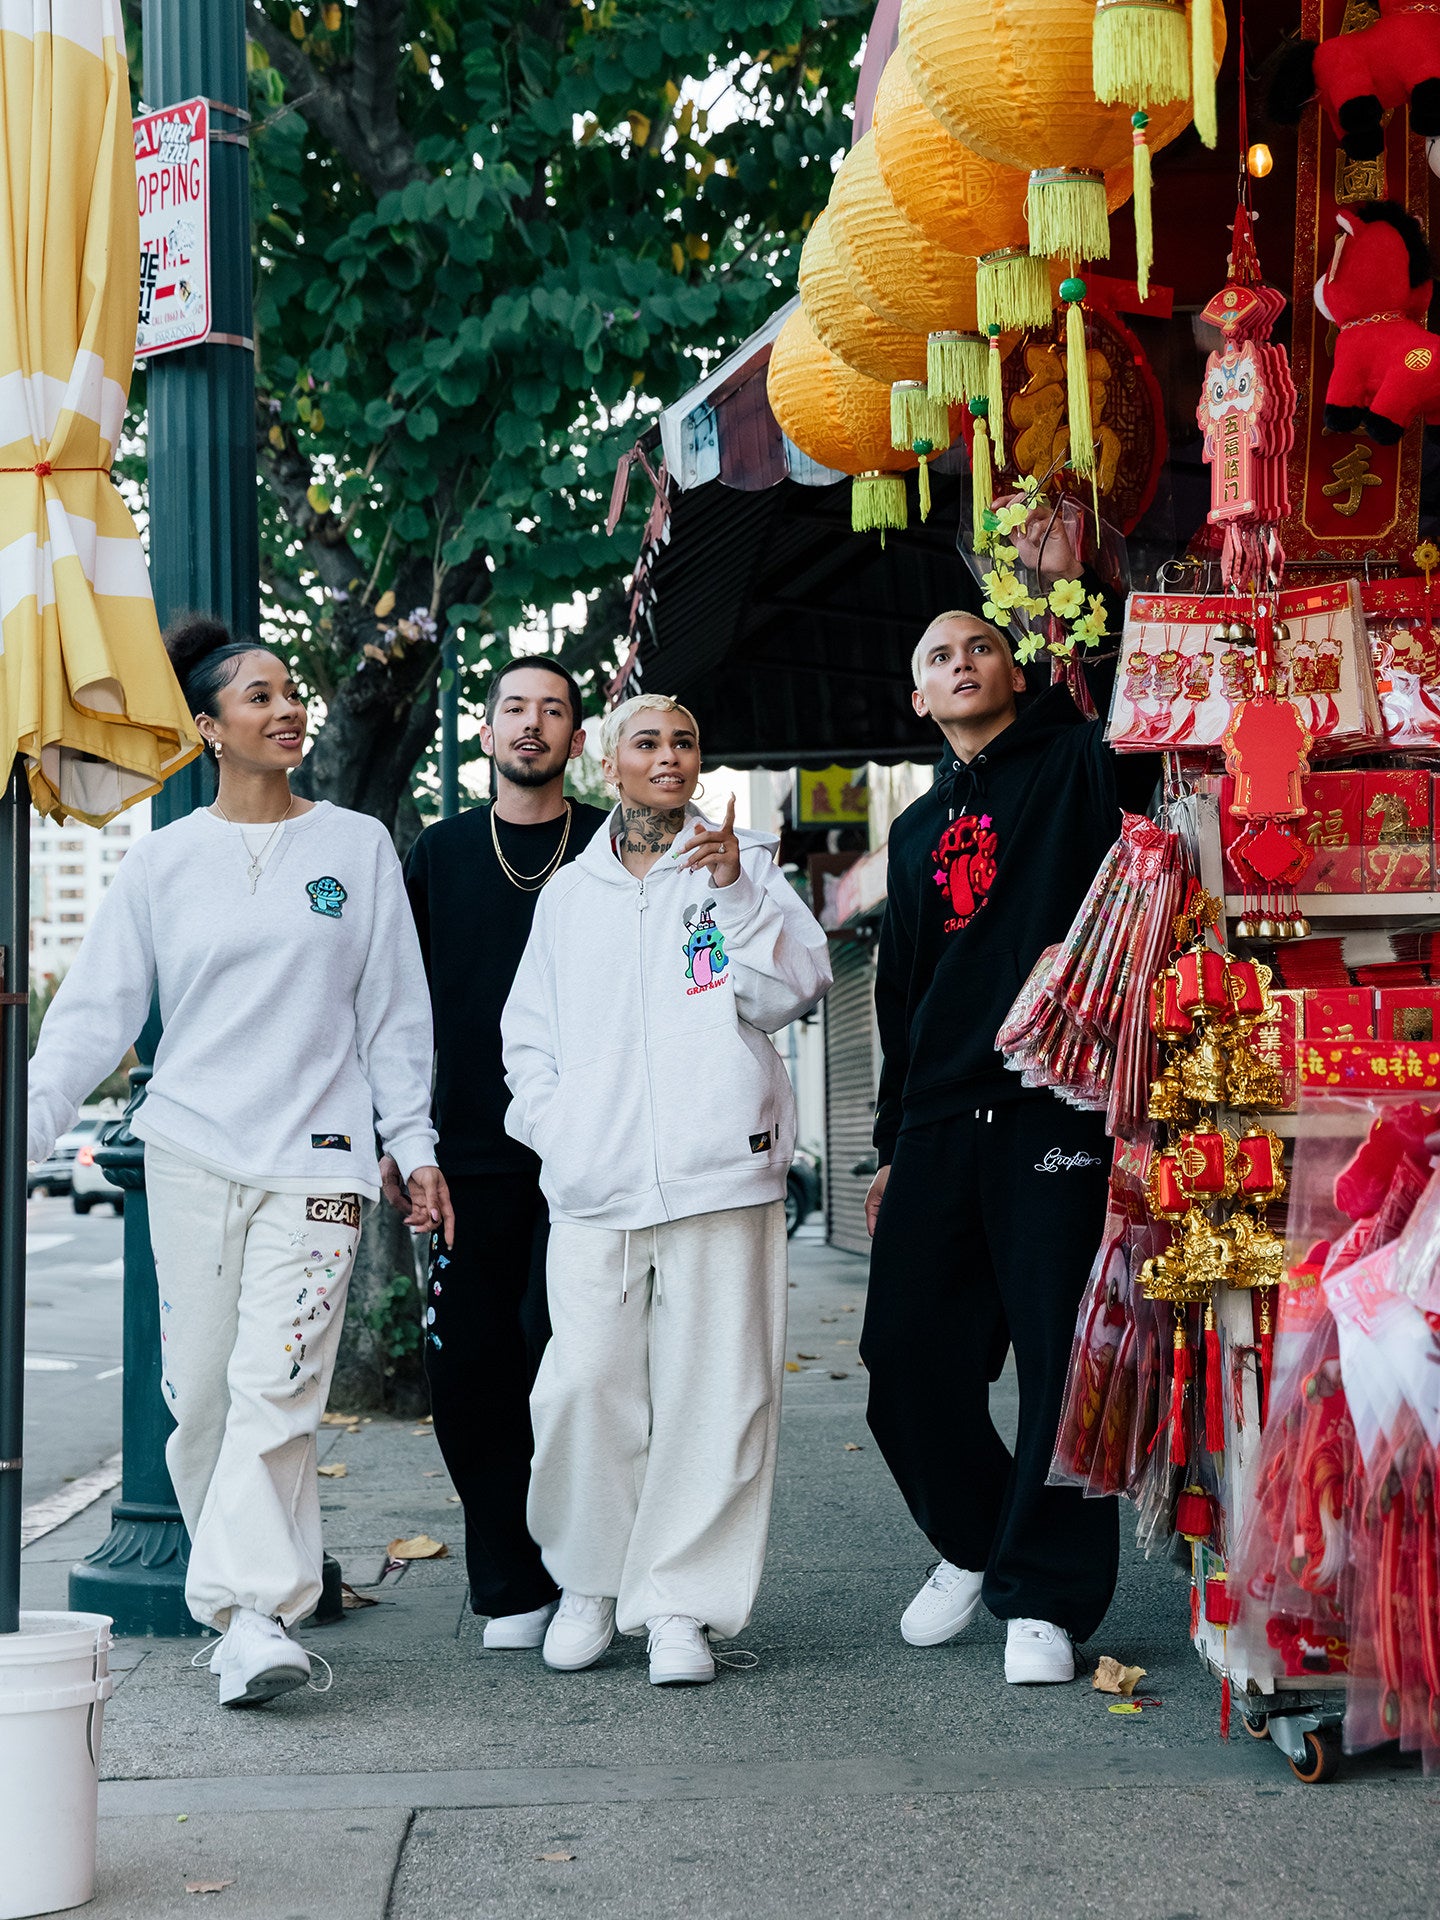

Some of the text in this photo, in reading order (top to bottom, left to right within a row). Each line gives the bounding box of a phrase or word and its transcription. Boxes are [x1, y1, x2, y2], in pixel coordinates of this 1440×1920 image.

[135, 105, 201, 156] AWY
[1224, 413, 1241, 502] 五福临门
[1322, 444, 1383, 517] 手
[1306, 808, 1350, 853] 福
